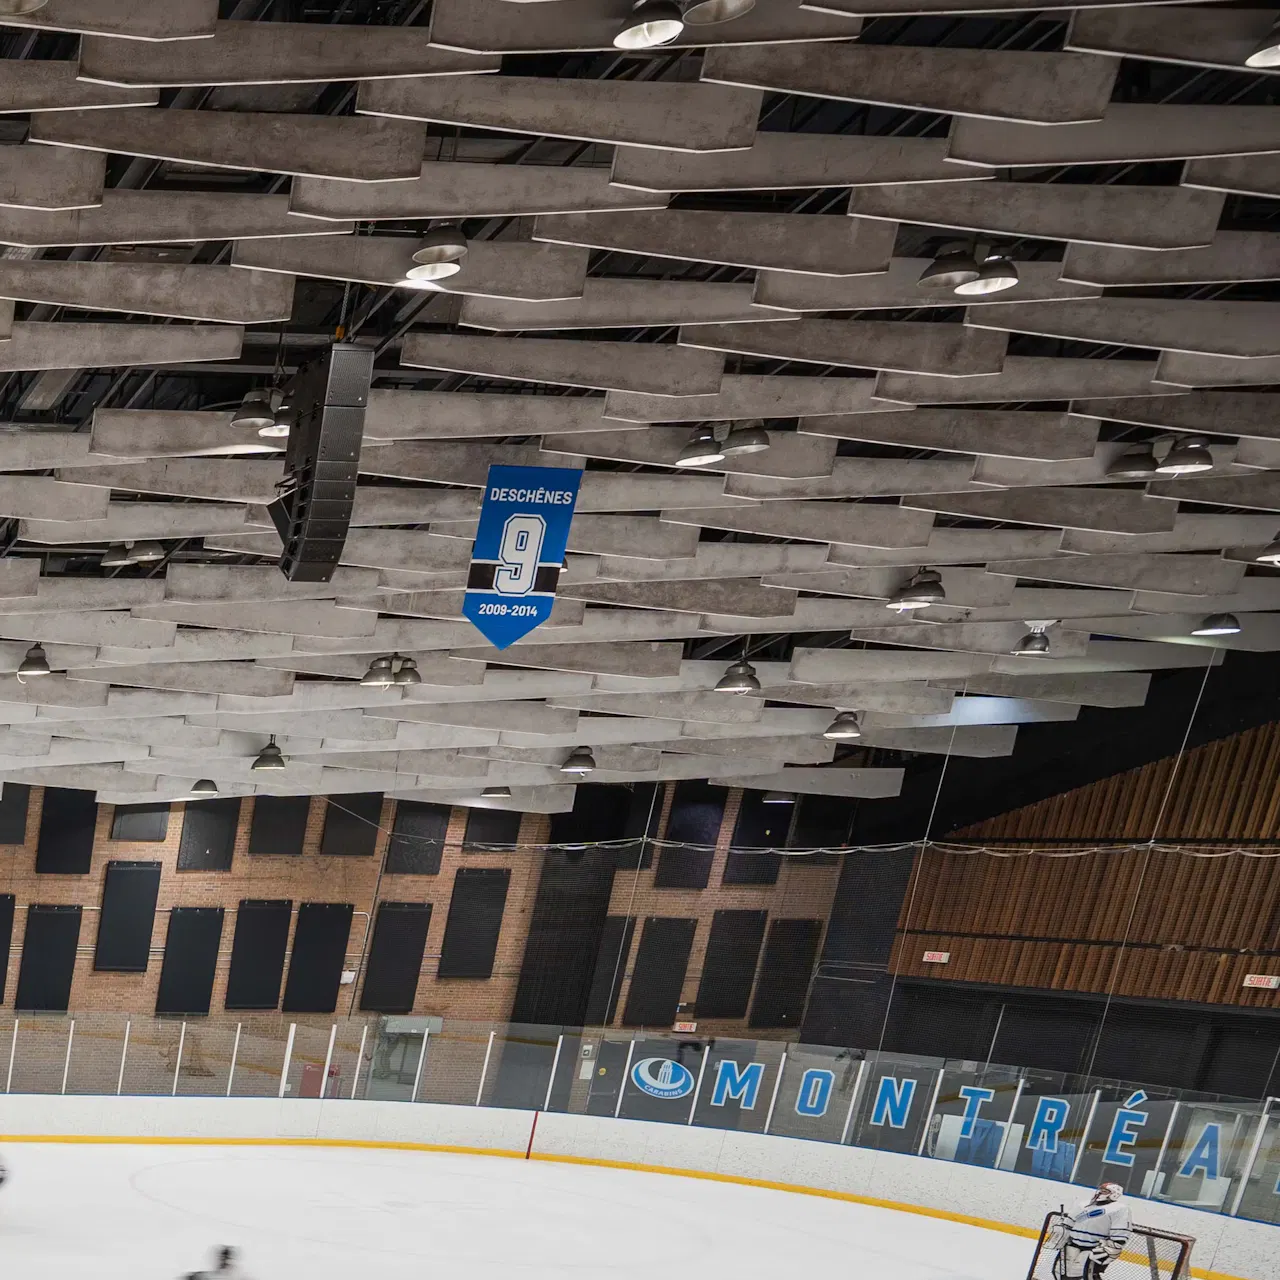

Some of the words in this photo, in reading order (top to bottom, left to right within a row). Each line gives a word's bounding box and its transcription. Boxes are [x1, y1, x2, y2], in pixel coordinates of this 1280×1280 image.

[490, 487, 573, 504] DESCHÊNES
[492, 513, 547, 597] 9
[479, 604, 538, 617] 2009-2014
[644, 1084, 683, 1096] CARABINS
